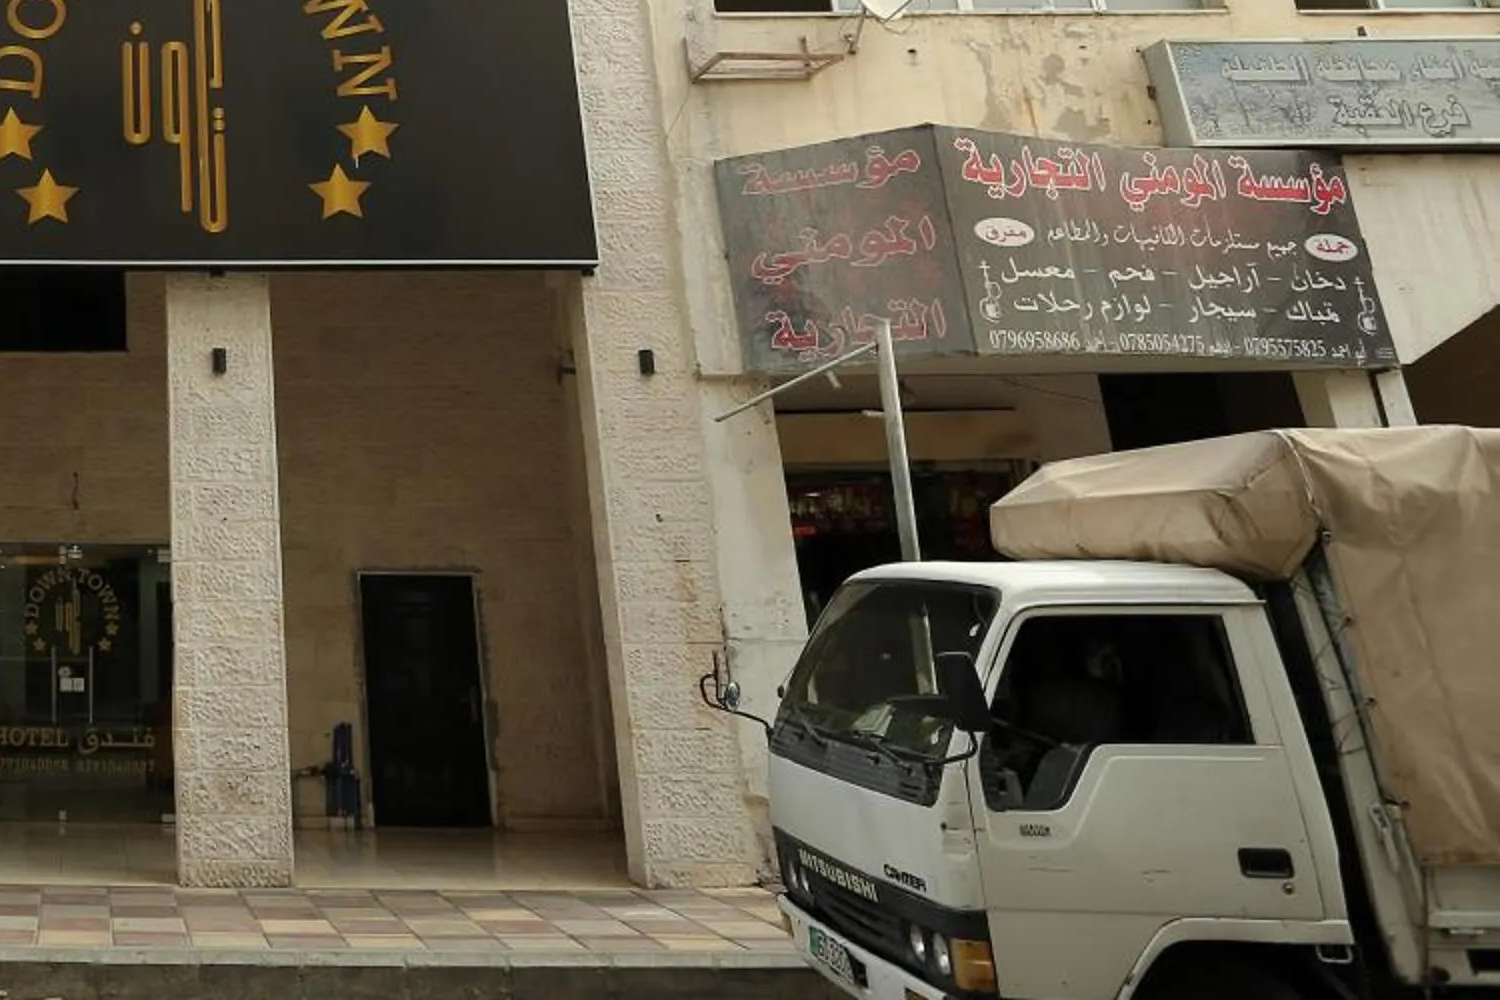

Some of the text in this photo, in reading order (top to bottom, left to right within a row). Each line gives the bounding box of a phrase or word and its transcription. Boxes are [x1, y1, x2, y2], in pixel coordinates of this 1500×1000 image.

[954, 137, 1107, 200] التجارية
[1228, 155, 1347, 215] مؤسسة
[1001, 256, 1075, 284] معسل
[1108, 264, 1155, 288] فحم
[1013, 290, 1093, 320] رحلات
[1101, 294, 1152, 324] لوازم
[23, 566, 71, 618] DOWN
[78, 567, 121, 620] TOWN
[78, 727, 155, 755] فندق
[797, 848, 879, 904] MITSUBISHI
